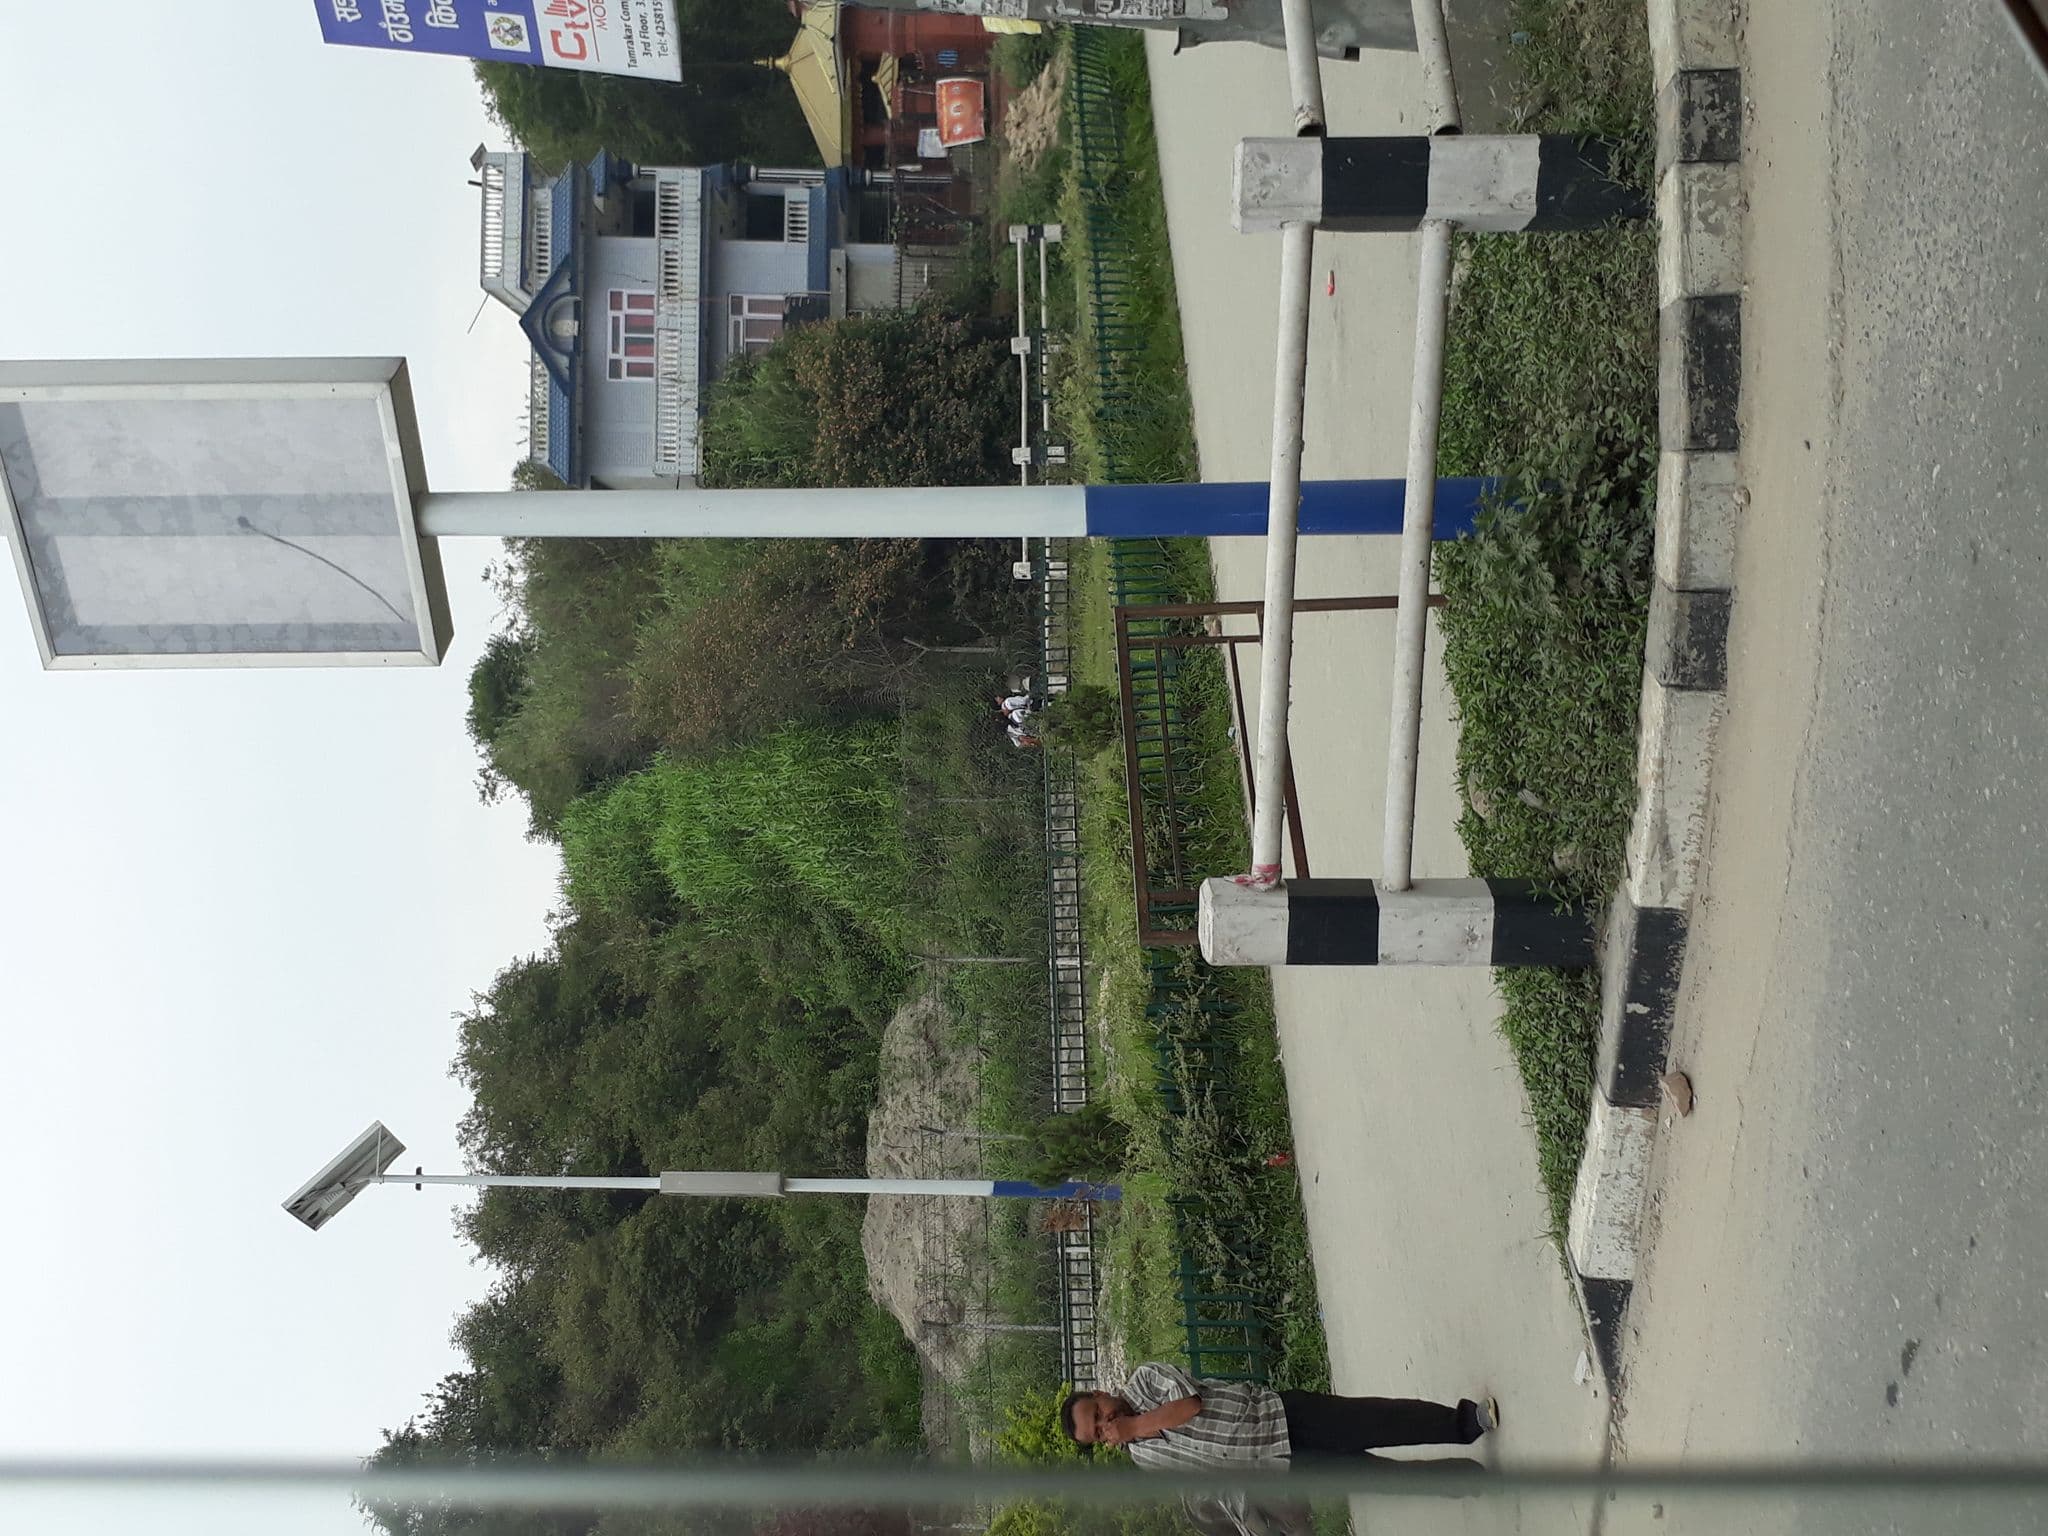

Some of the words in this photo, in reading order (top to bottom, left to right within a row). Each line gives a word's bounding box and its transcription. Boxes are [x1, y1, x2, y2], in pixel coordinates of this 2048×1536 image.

[620, 0, 632, 22] Com
[652, 0, 666, 37] 425815
[638, 12, 650, 40] Floor,
[623, 23, 639, 68] Tamrakar
[641, 42, 653, 58] 3rd
[657, 39, 669, 58] Tel:
